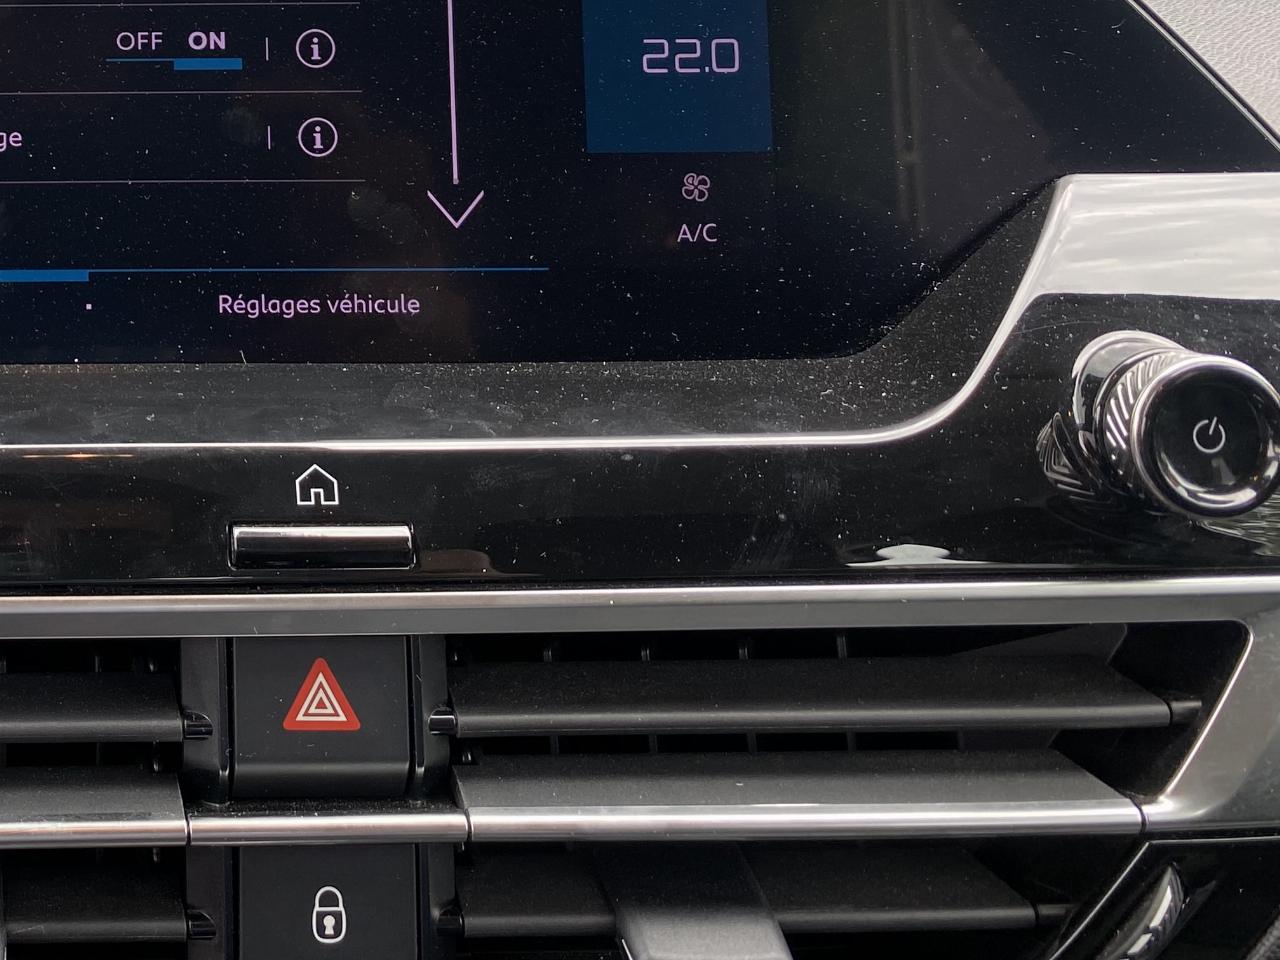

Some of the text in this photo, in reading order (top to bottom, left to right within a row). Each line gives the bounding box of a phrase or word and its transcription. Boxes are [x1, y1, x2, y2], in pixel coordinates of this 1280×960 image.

[116, 31, 226, 51] OFF ON
[642, 38, 740, 74] 22.0
[677, 223, 718, 243] A/C
[218, 293, 420, 319] Réglages véhicule
